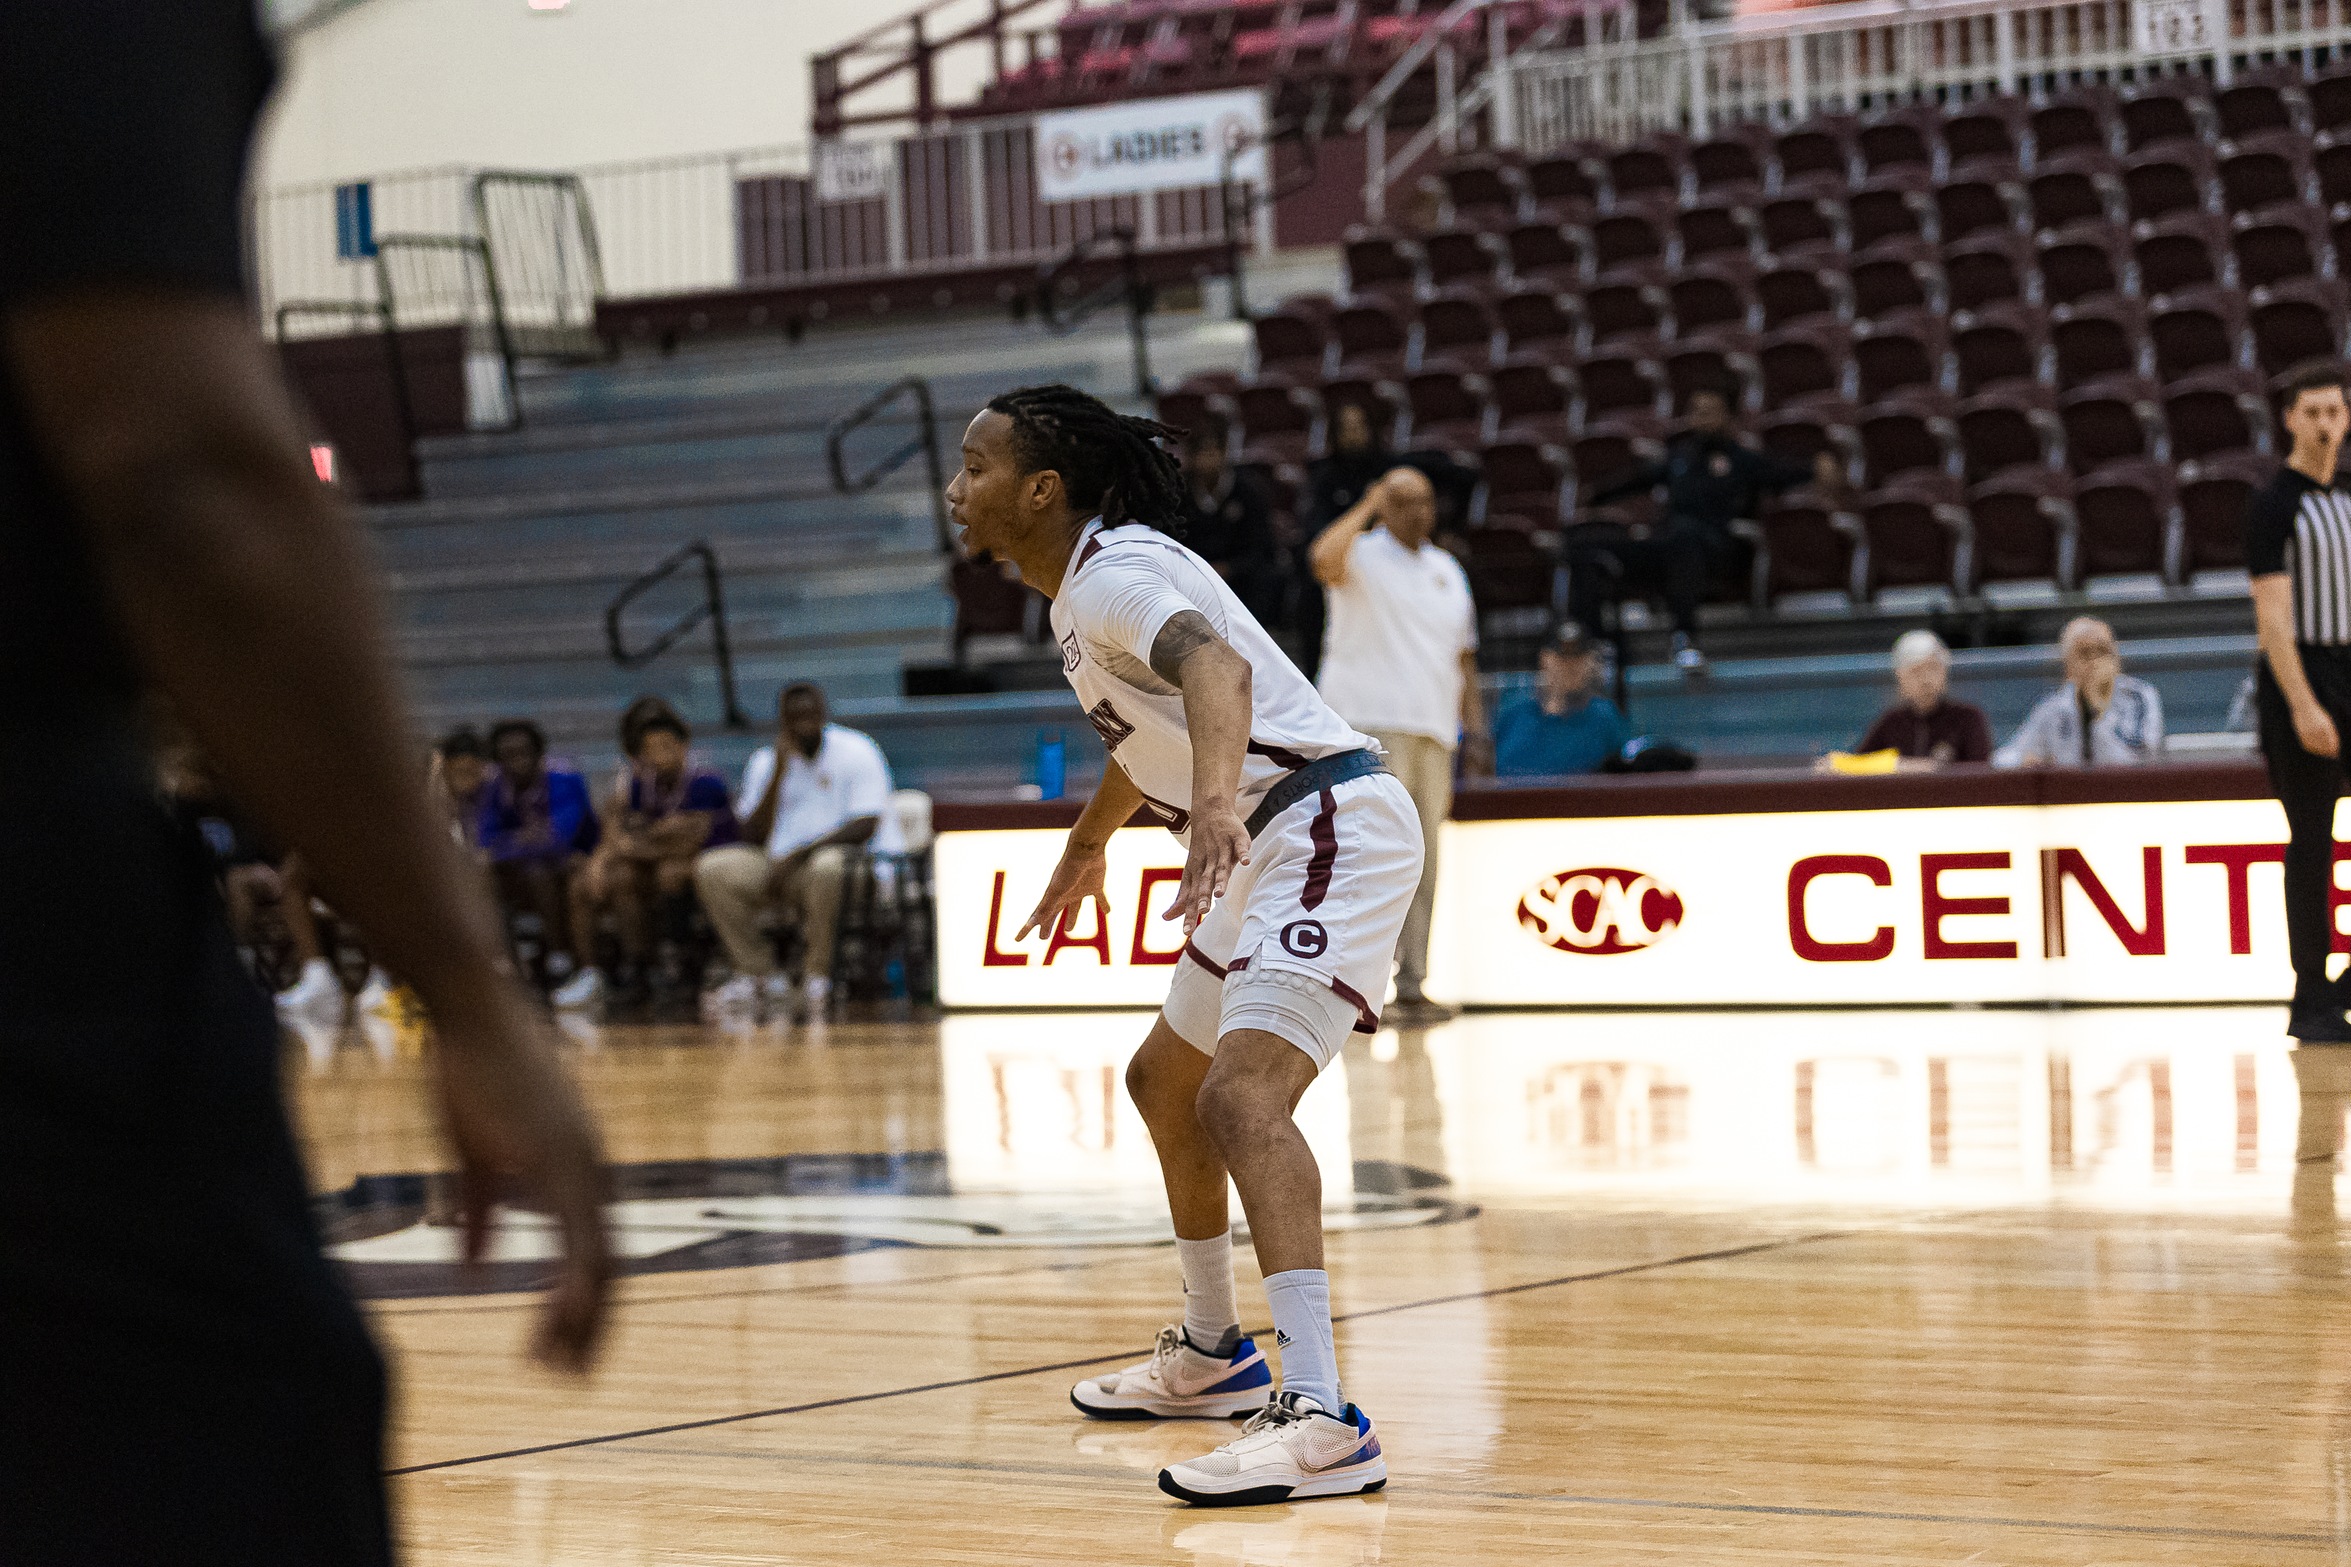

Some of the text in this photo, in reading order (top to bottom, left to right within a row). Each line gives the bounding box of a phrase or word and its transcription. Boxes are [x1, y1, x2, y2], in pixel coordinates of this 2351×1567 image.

[1286, 923, 1323, 955] C
[1517, 872, 1681, 950] SCAC
[1788, 842, 2351, 962] CENT
